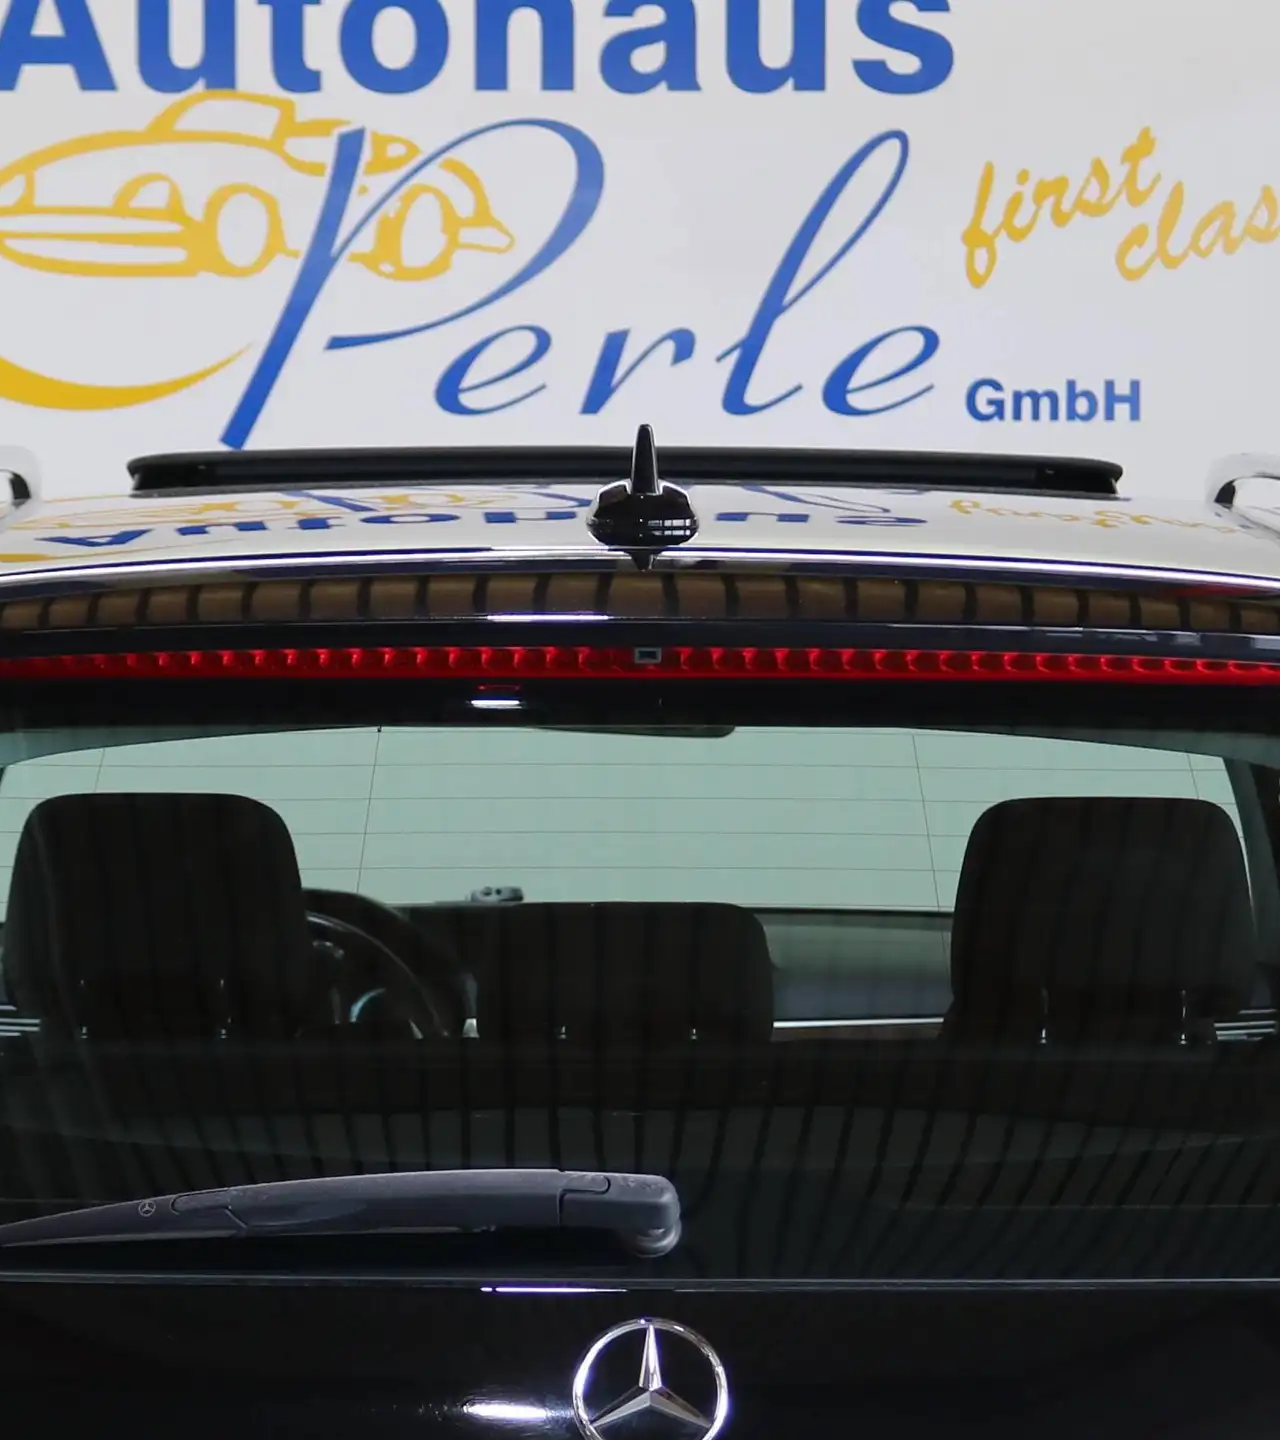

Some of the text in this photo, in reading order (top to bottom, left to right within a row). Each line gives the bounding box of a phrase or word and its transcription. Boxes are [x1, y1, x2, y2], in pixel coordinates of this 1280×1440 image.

[220, 118, 1142, 450] Perle GmbH
[961, 126, 1160, 289] first
